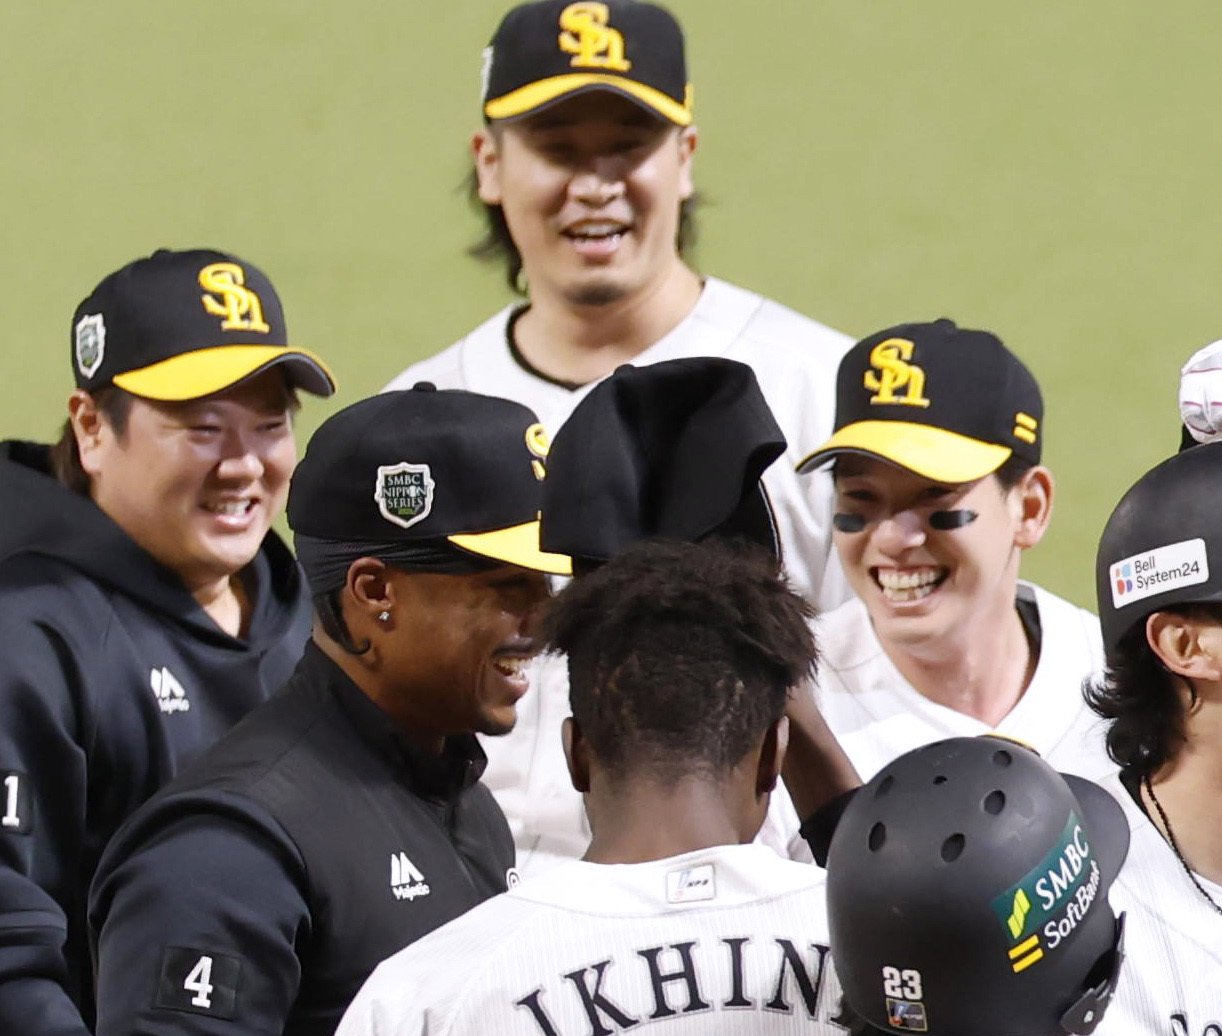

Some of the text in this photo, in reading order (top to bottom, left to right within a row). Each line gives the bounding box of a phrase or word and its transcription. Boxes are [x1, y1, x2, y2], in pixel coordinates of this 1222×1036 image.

[387, 474, 421, 486] SMBC
[1134, 555, 1156, 574] Bell
[1136, 560, 1200, 590] System24
[1035, 825, 1090, 911] SMBC
[183, 955, 214, 1009] 4
[882, 966, 923, 1000] 23
